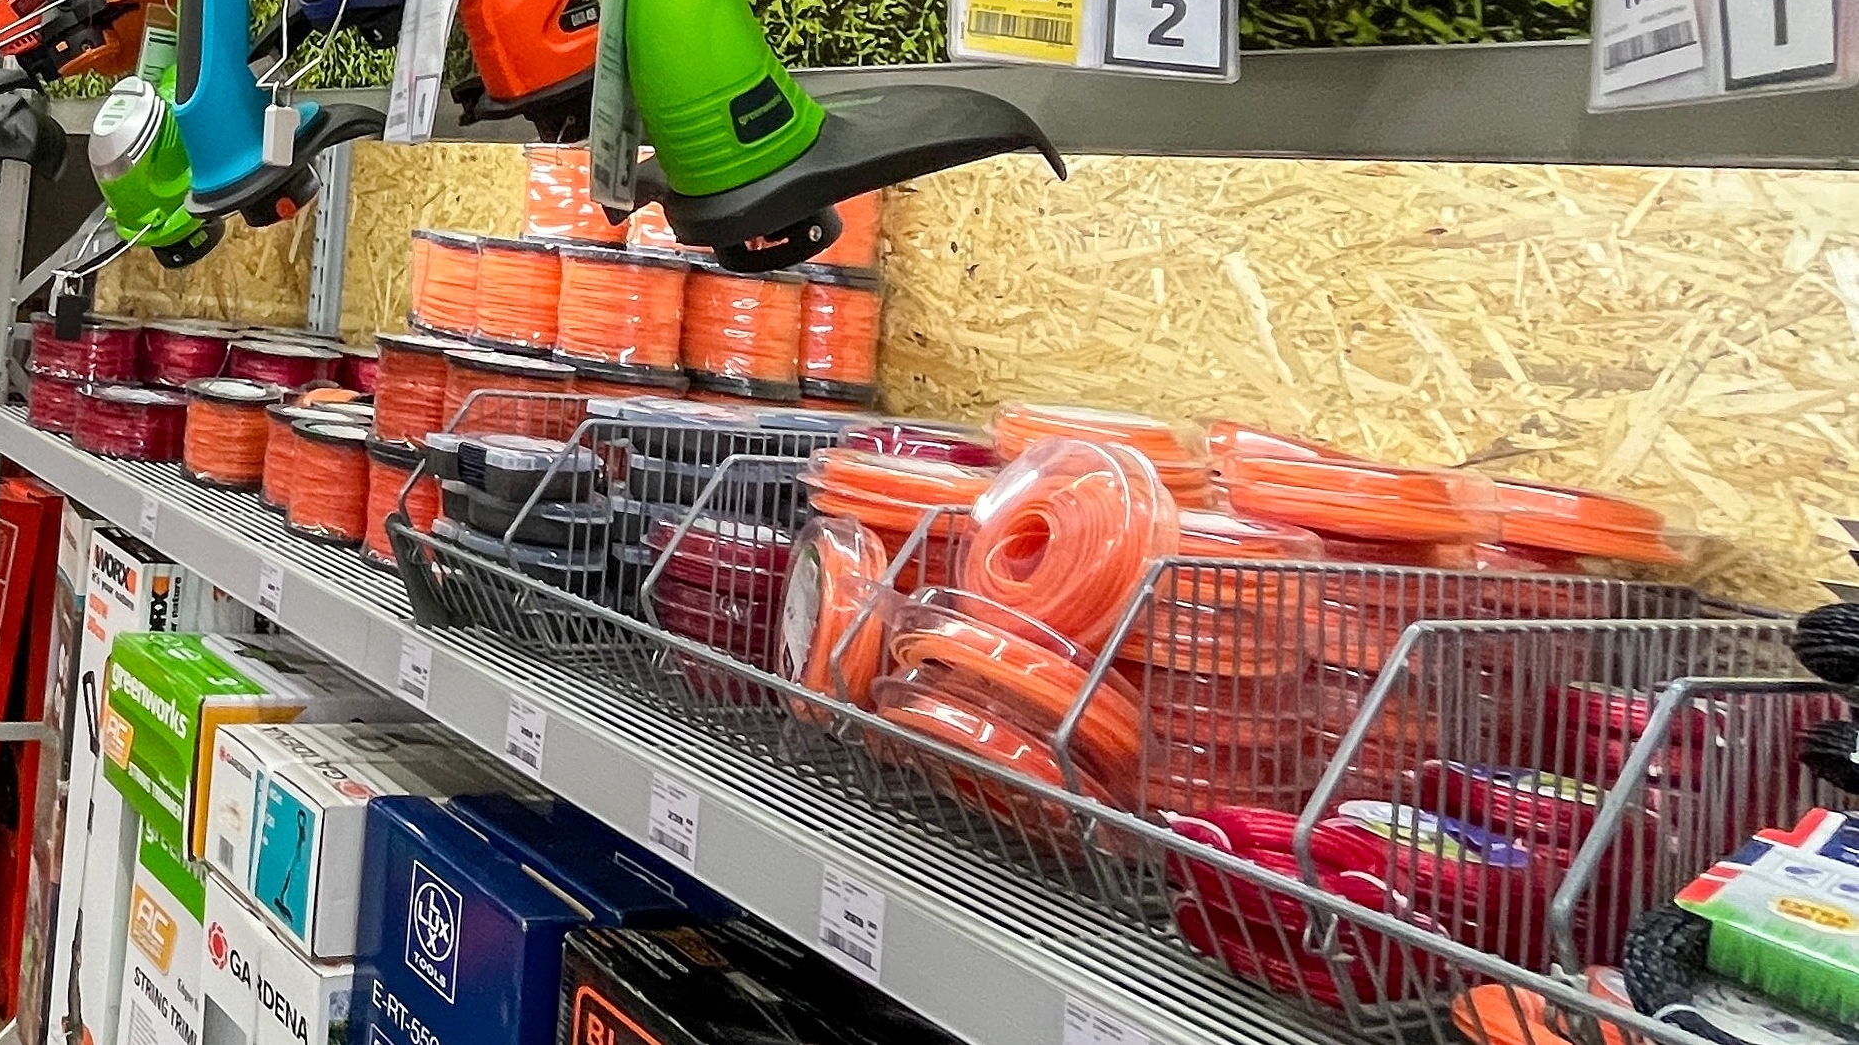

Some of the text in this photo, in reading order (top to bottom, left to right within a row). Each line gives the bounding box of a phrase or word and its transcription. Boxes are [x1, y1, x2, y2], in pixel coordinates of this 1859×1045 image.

[92, 543, 137, 596] WORX
[110, 661, 191, 741] greenworks
[133, 965, 170, 1020] STRING
[412, 950, 447, 989] TOOLS
